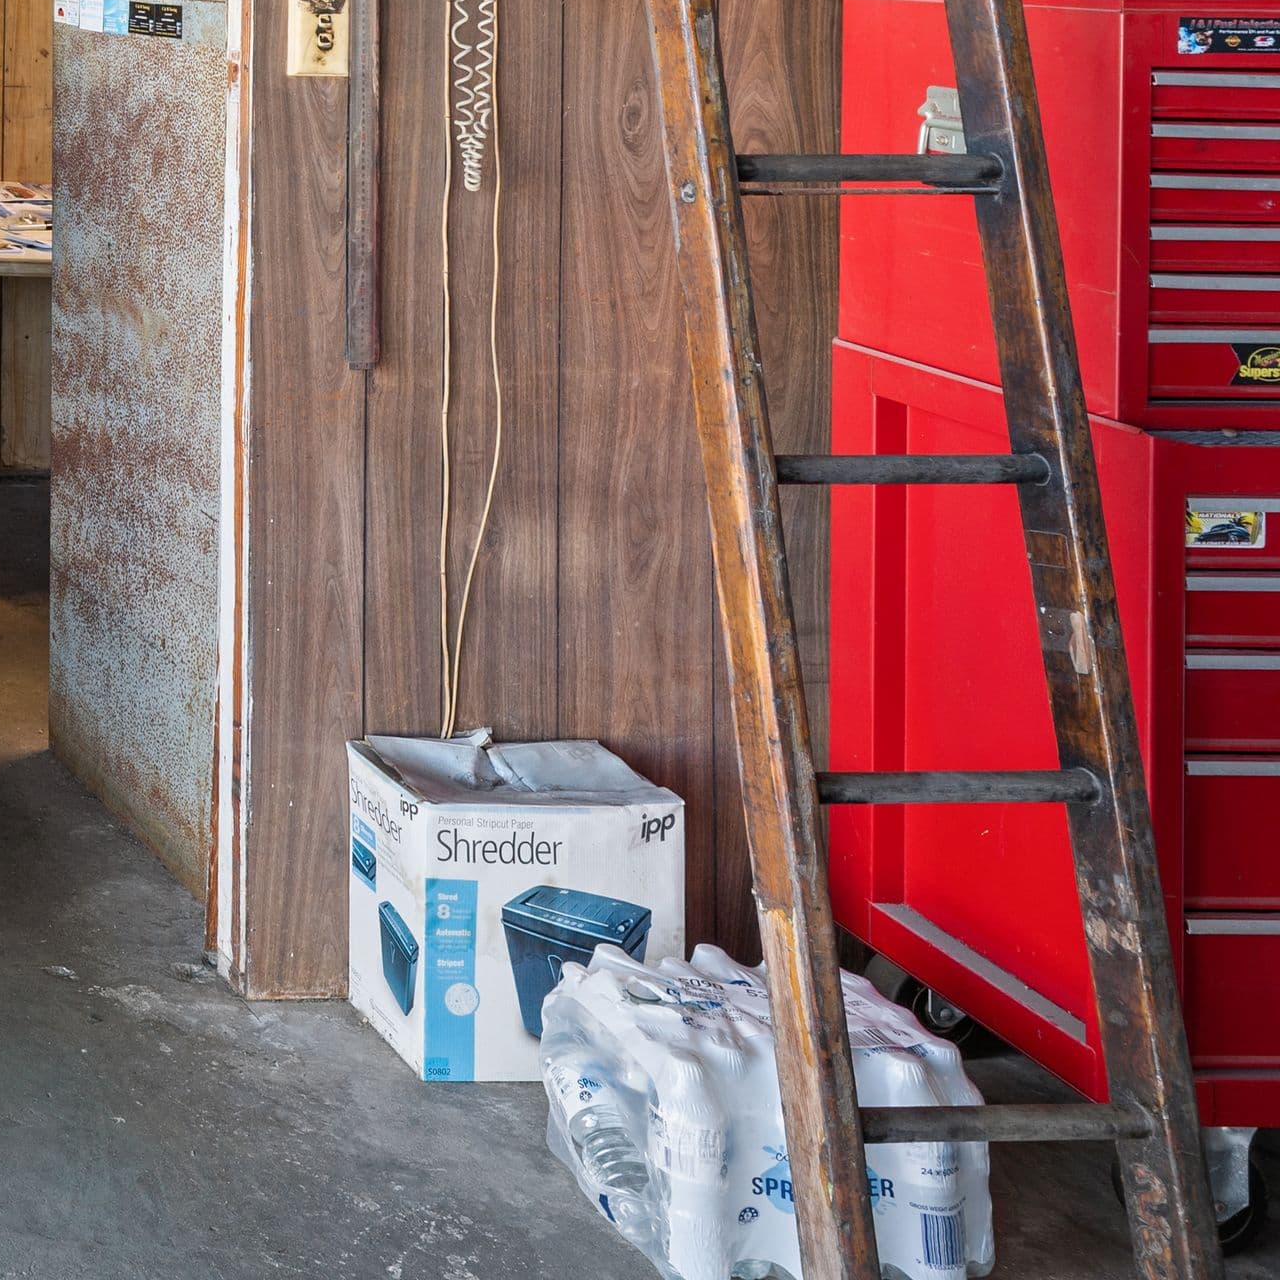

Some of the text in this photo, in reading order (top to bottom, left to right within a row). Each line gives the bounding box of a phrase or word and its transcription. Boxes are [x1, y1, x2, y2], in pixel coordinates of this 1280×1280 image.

[350, 778, 402, 844] Shredder
[400, 793, 419, 821] ipp
[438, 815, 534, 830] Personal Stripcut Paper
[640, 812, 676, 843] ipp
[436, 828, 564, 866] Shredder
[437, 892, 458, 902] Shred
[437, 904, 451, 920] 8
[436, 928, 472, 938] Automatic
[920, 1167, 933, 1176] 24
